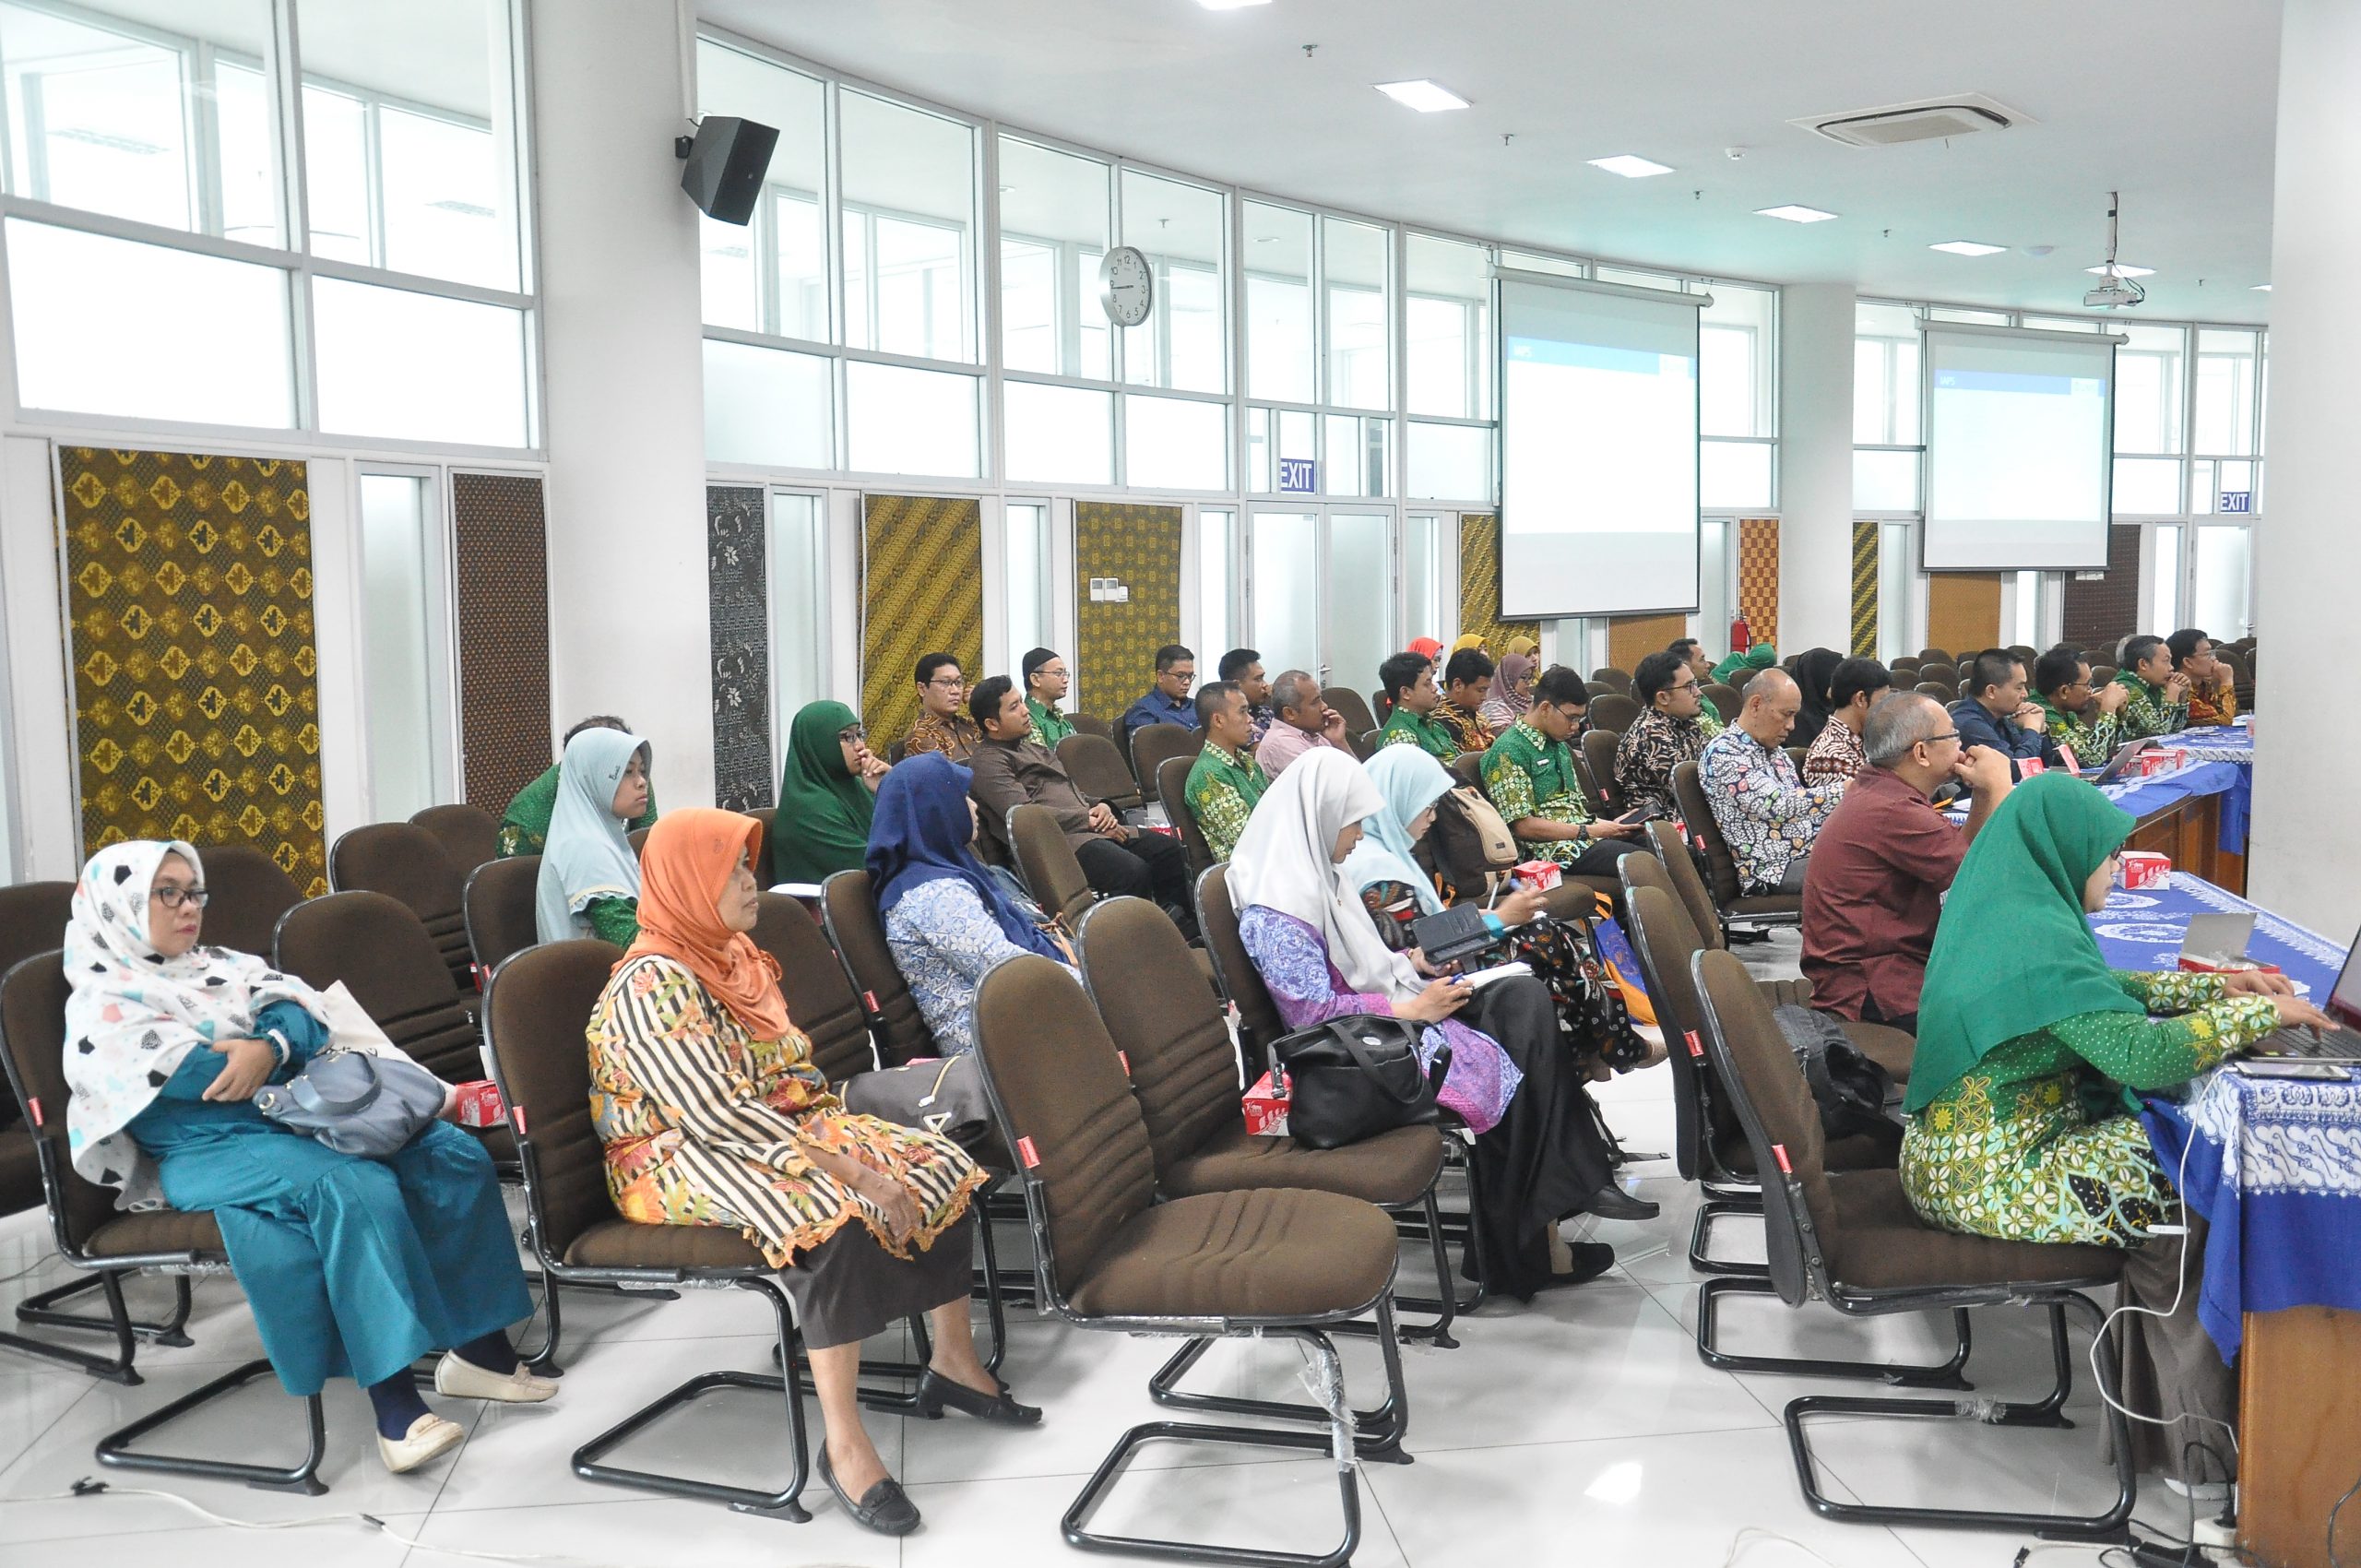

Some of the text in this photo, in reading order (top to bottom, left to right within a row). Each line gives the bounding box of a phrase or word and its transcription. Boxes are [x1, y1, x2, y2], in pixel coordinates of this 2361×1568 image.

[1124, 255, 1131, 265] 12
[1110, 267, 1118, 275] 10
[1139, 270, 1144, 279] 2
[1141, 285, 1145, 294] 3
[1118, 304, 1122, 314] 7
[1134, 307, 1139, 316] 5
[1126, 310, 1131, 318] 6
[1280, 461, 1312, 489] EXIT
[2221, 493, 2248, 511] EXIT
